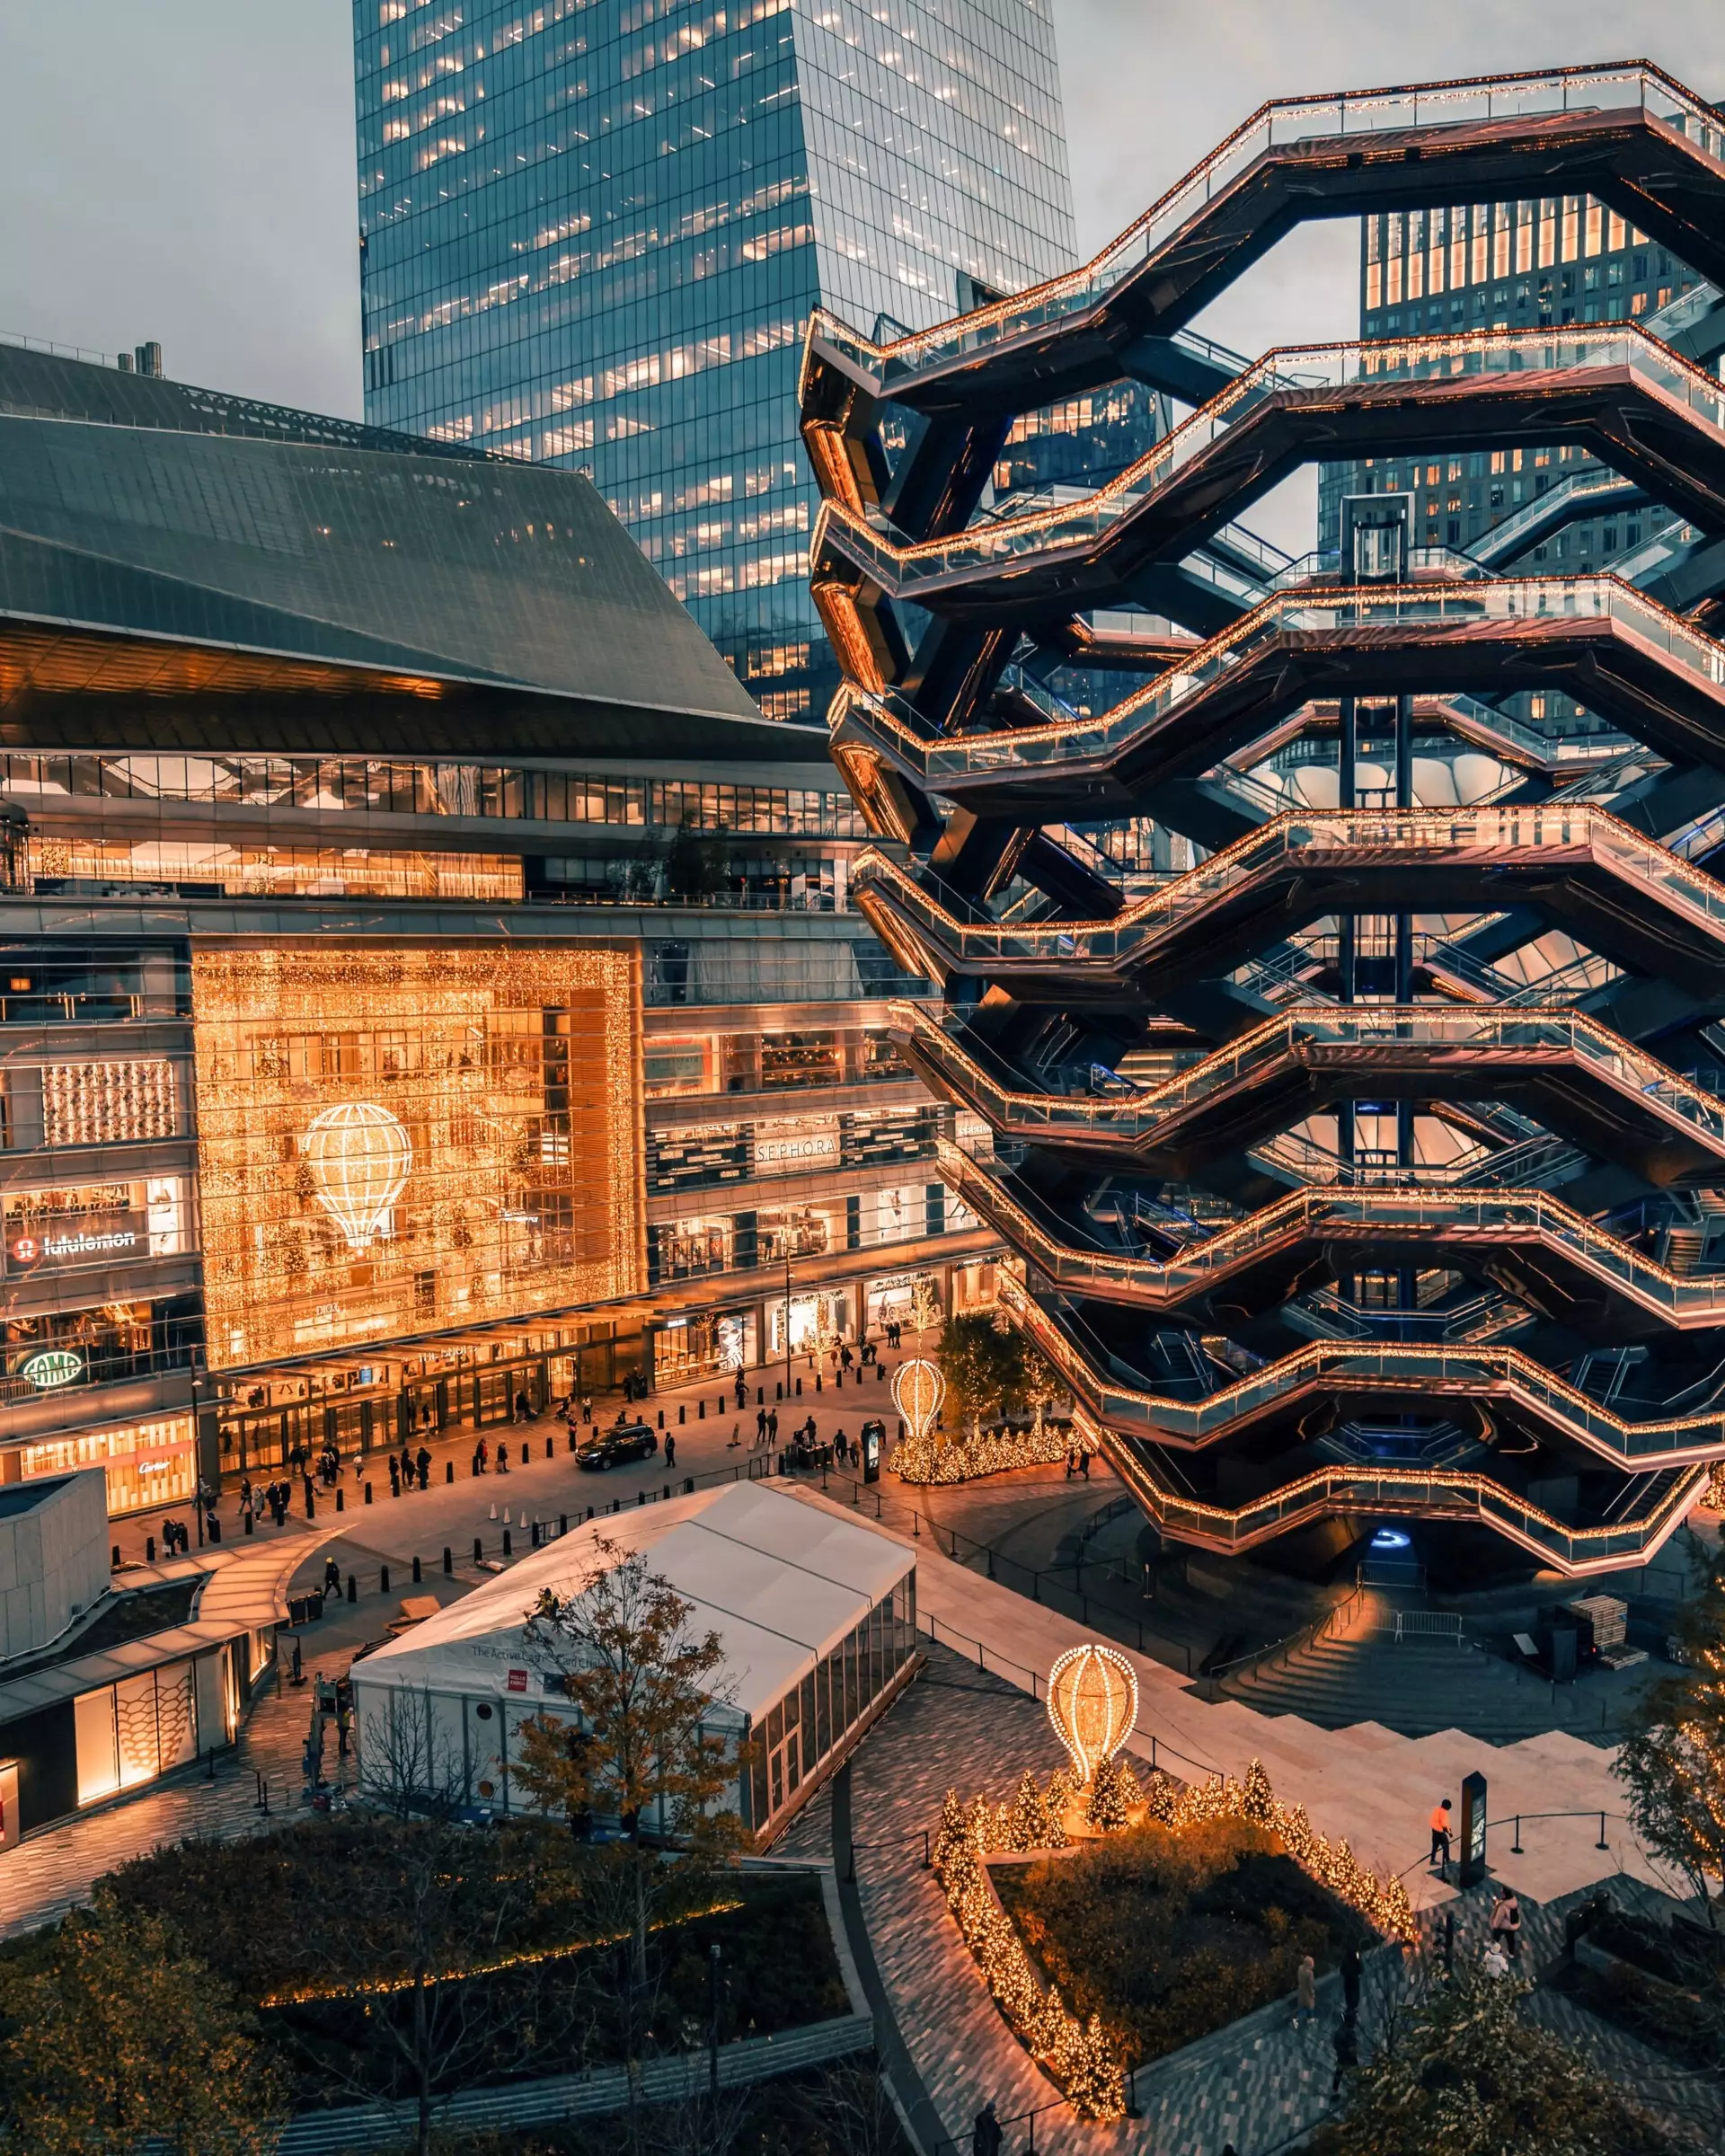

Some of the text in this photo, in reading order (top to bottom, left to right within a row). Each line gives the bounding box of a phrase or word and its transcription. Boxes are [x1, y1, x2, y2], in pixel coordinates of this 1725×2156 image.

[756, 1137, 836, 1161] SEPHORA
[44, 1232, 135, 1256] lululemon
[316, 1302, 339, 1316] DIOR
[27, 1354, 79, 1383] CAMP
[138, 1462, 172, 1474] Cartier
[472, 1646, 490, 1658] The
[491, 1647, 520, 1661] Active
